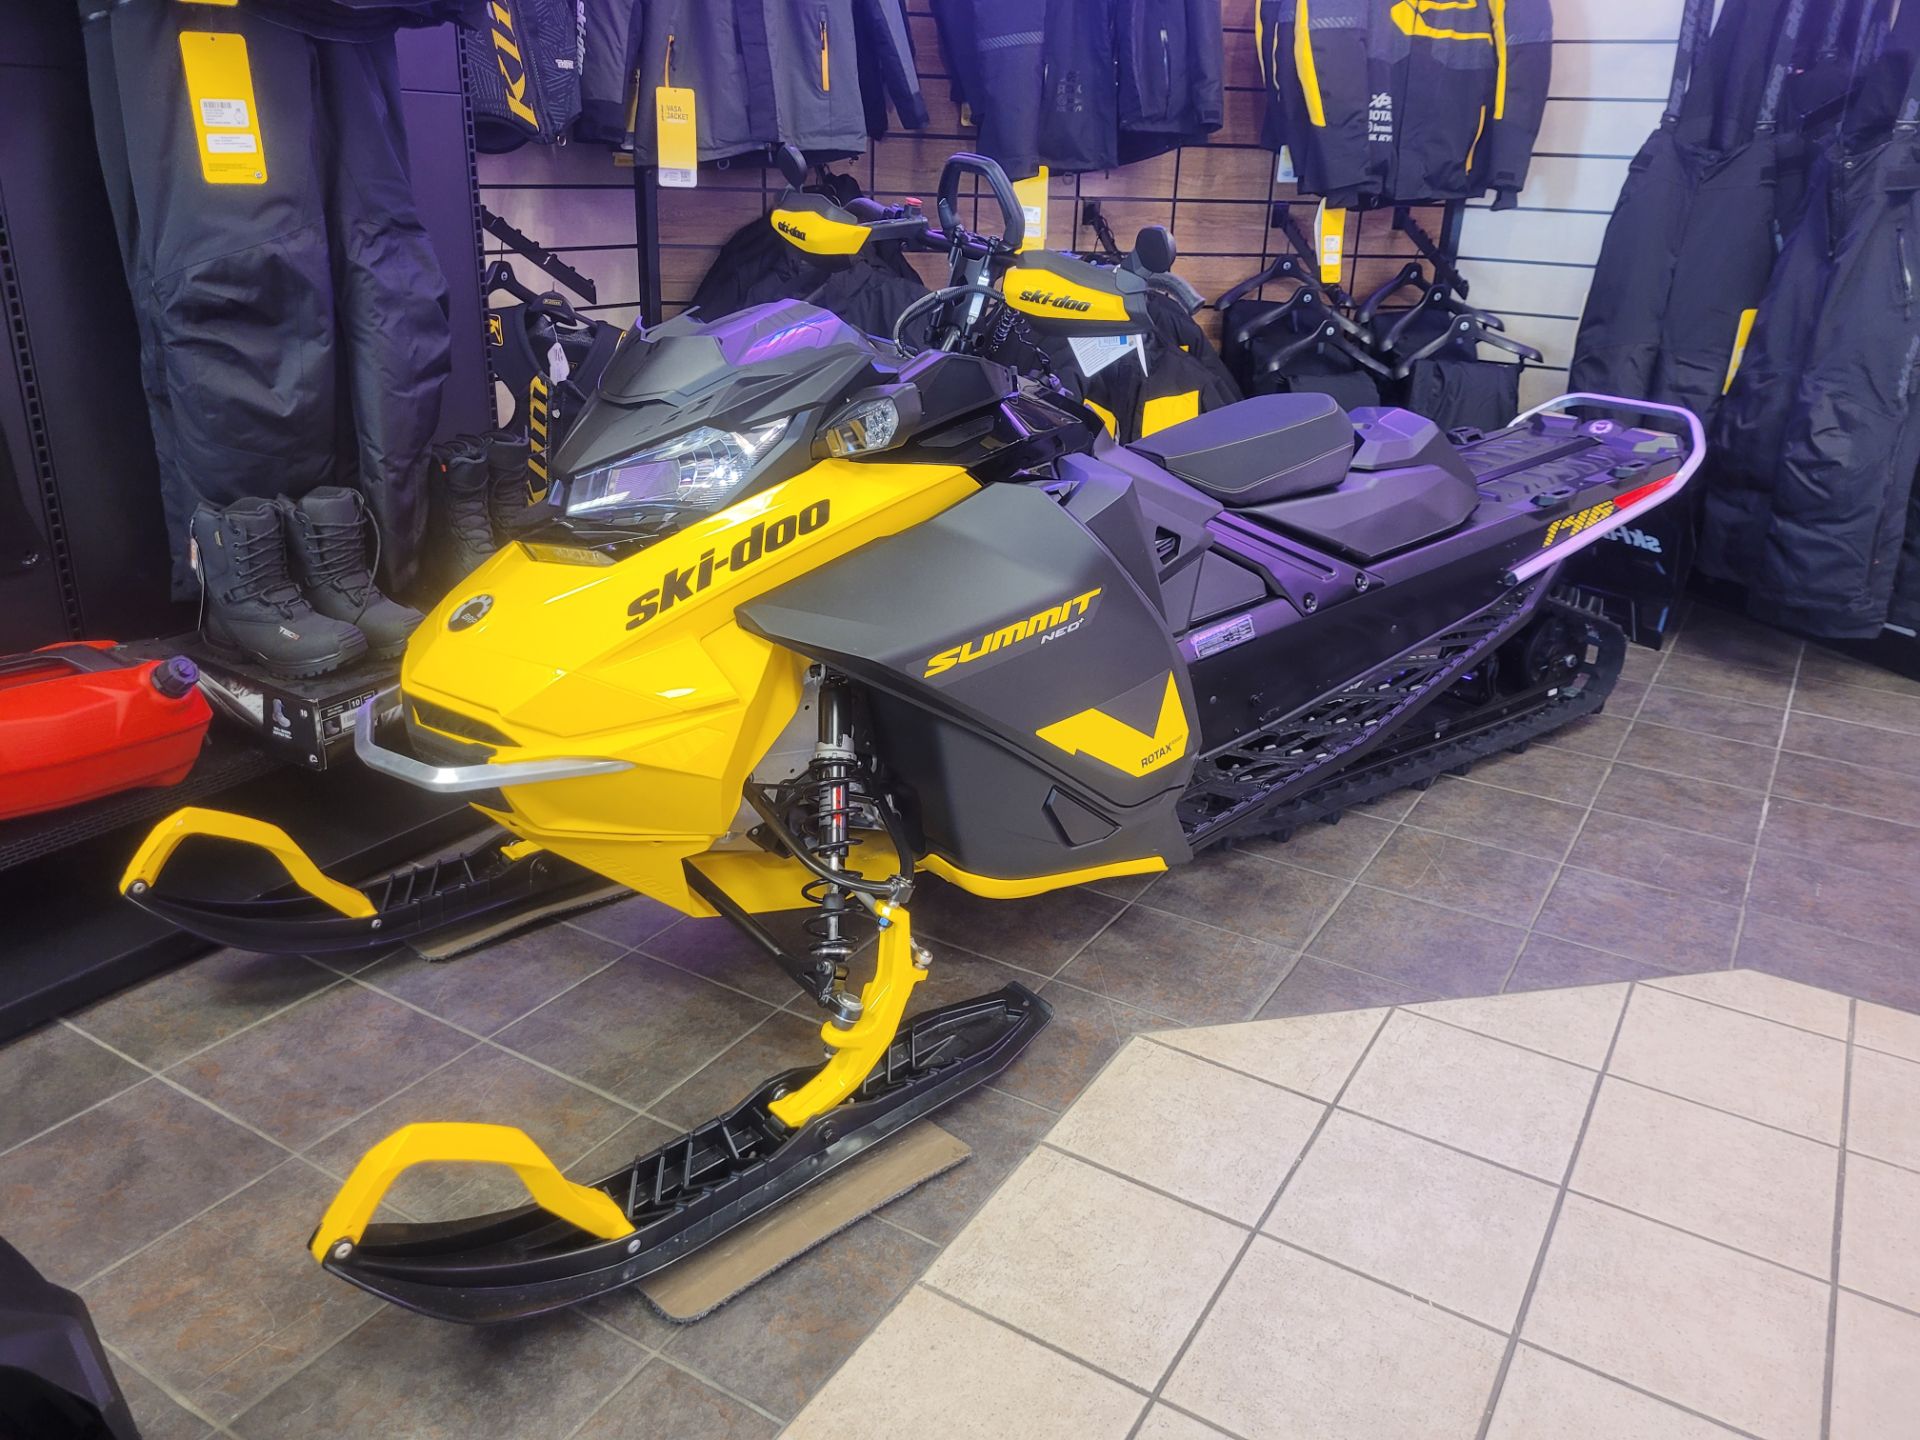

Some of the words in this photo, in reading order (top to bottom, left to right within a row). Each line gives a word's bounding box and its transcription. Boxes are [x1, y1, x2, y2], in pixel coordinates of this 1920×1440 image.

[665, 112, 689, 121] JACKET
[1019, 289, 1092, 312] ski-doo
[625, 498, 830, 631] ski-doo
[924, 587, 1102, 679] SUMMIT
[300, 709, 308, 718] 10
[351, 698, 361, 707] 10
[1141, 742, 1172, 768] ROTAX
